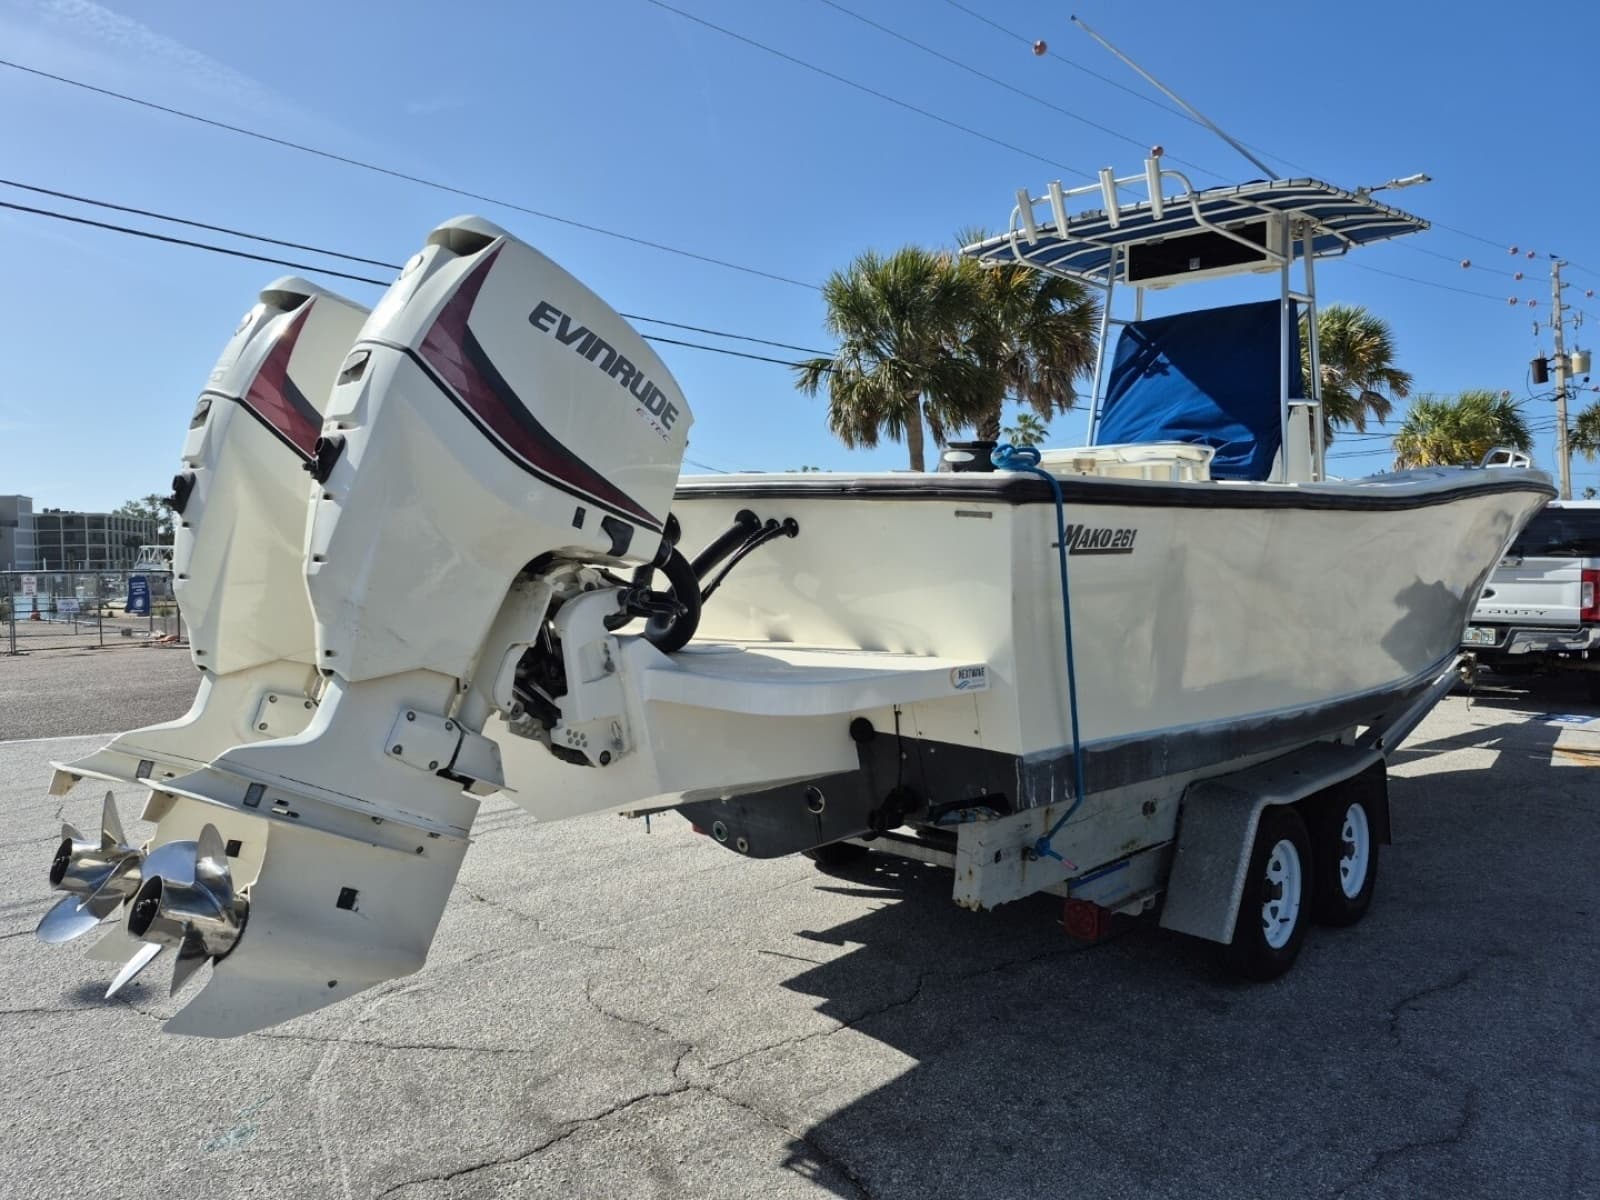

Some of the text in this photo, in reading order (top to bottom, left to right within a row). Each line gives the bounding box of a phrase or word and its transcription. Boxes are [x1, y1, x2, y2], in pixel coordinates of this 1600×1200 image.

[528, 300, 679, 431] EVINRUDE
[1062, 524, 1138, 553] MAKO 261
